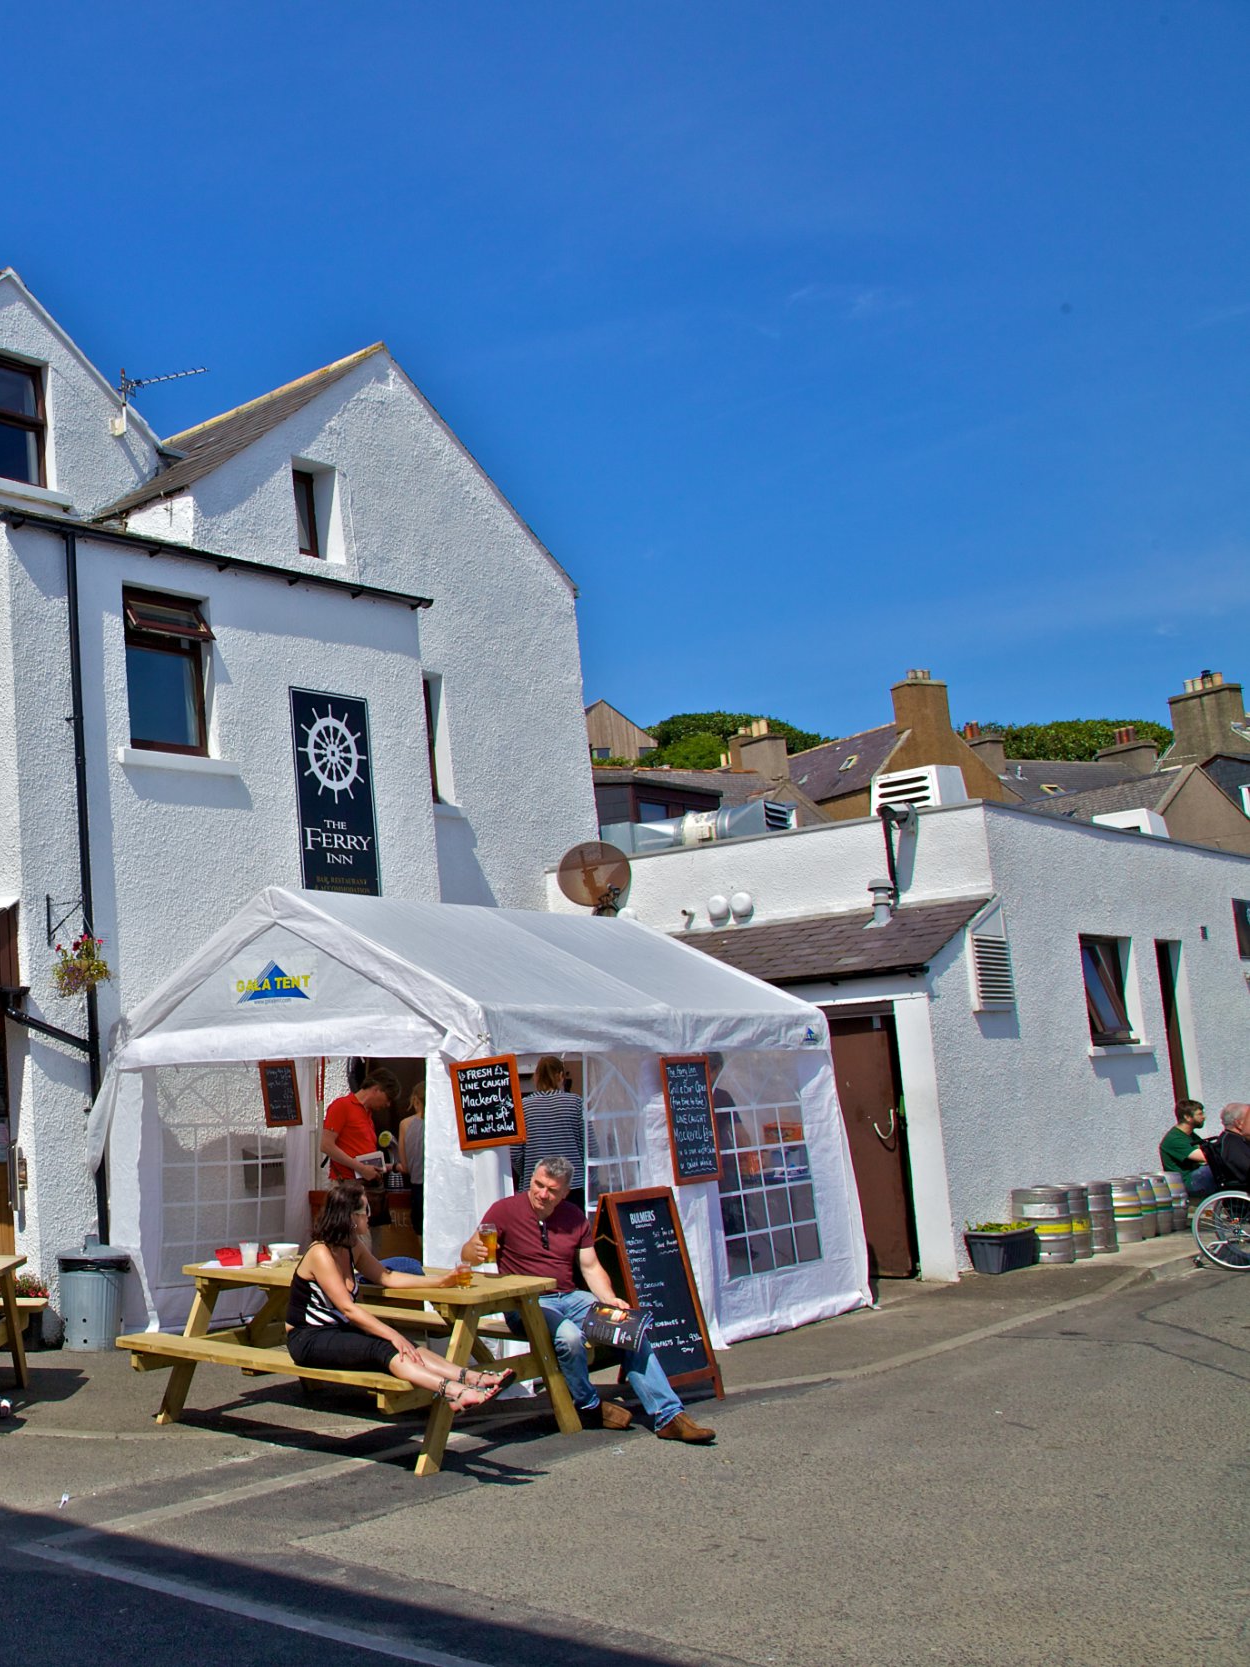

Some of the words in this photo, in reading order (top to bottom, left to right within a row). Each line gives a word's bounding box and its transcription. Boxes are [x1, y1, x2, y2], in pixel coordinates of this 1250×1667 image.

[323, 819, 347, 830] THE
[303, 827, 372, 851] FERRY
[326, 852, 353, 865] INN
[236, 979, 271, 993] GALA
[274, 975, 311, 990] TENT
[467, 1067, 493, 1080] FRESH
[460, 1081, 480, 1091] LINE
[482, 1077, 510, 1088] CAUGHT
[461, 1087, 505, 1109] Mackerel
[465, 1112, 484, 1123] Grilled
[486, 1111, 494, 1121] in
[495, 1106, 510, 1121] soft
[467, 1124, 478, 1135] roll
[480, 1121, 496, 1133] with
[496, 1121, 515, 1131] salad
[630, 1210, 656, 1224] BULMERS
